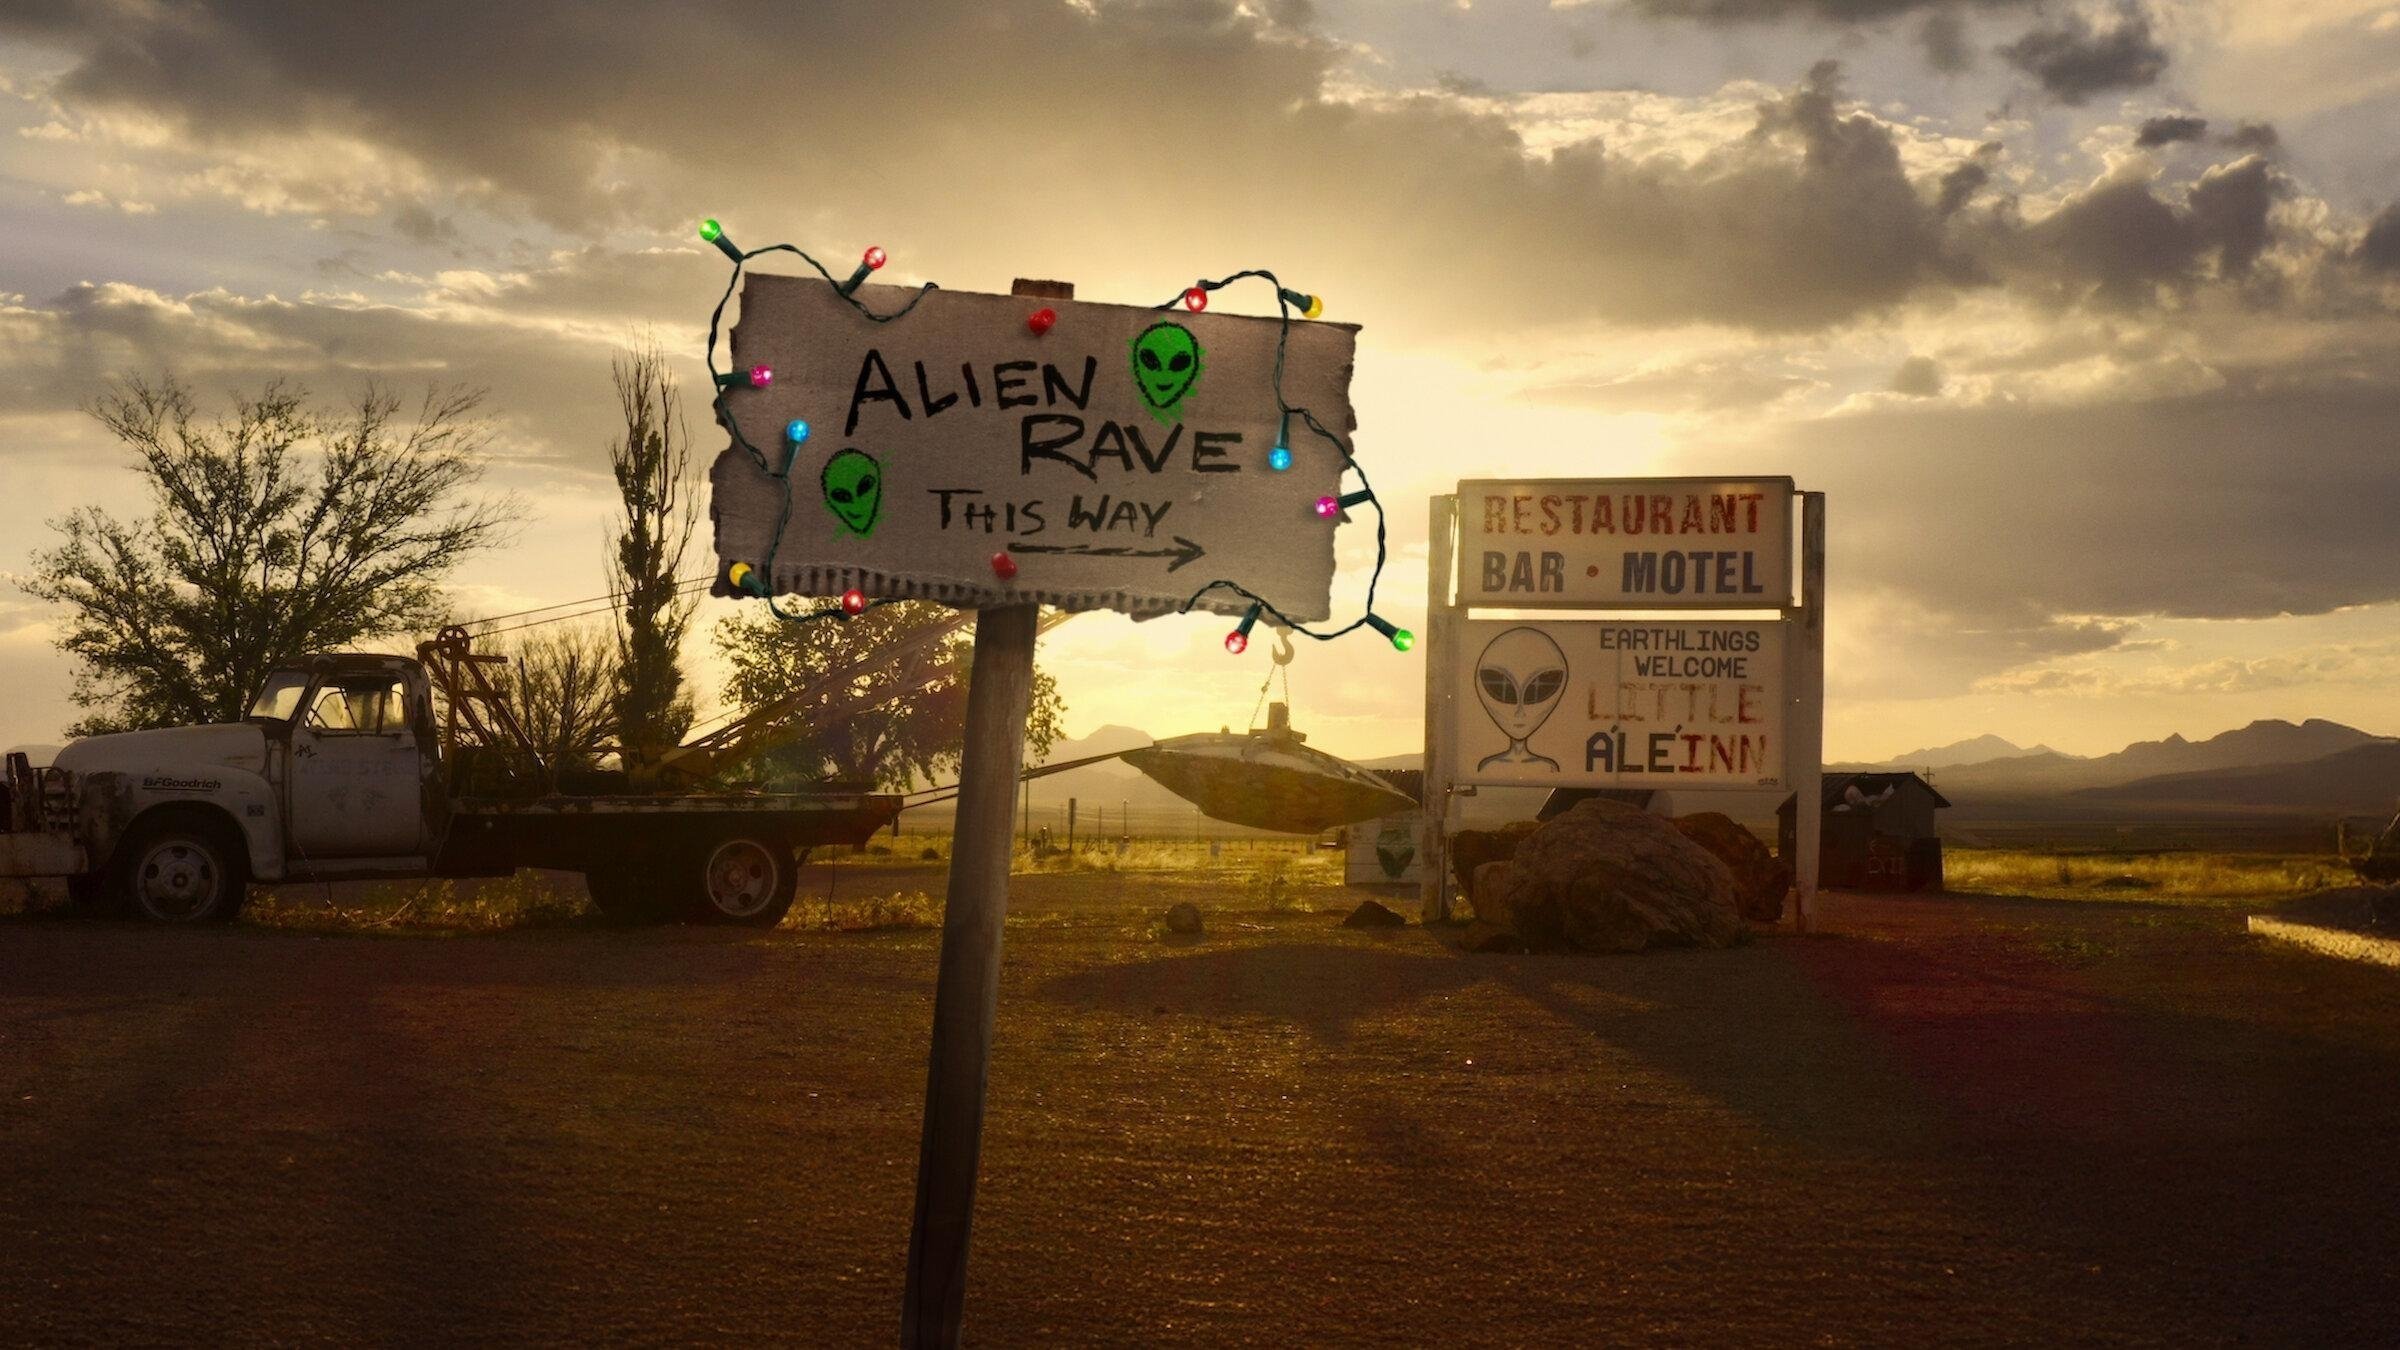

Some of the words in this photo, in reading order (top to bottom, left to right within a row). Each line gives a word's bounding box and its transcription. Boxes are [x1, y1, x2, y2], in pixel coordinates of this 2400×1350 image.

[845, 349, 1097, 436] ALIEN
[1021, 413, 1243, 481] RAVE
[927, 489, 1046, 535] THIS
[1068, 495, 1173, 538] WAY
[1483, 494, 1764, 535] RESTAURANT
[1482, 551, 1565, 592] BAR
[1621, 551, 1764, 594] MOTEL
[1600, 628, 1760, 652] EARTHLINGS
[1634, 656, 1748, 679] WELCOME
[1587, 682, 1766, 724] LITTLE
[143, 777, 221, 789] BFGoodrich
